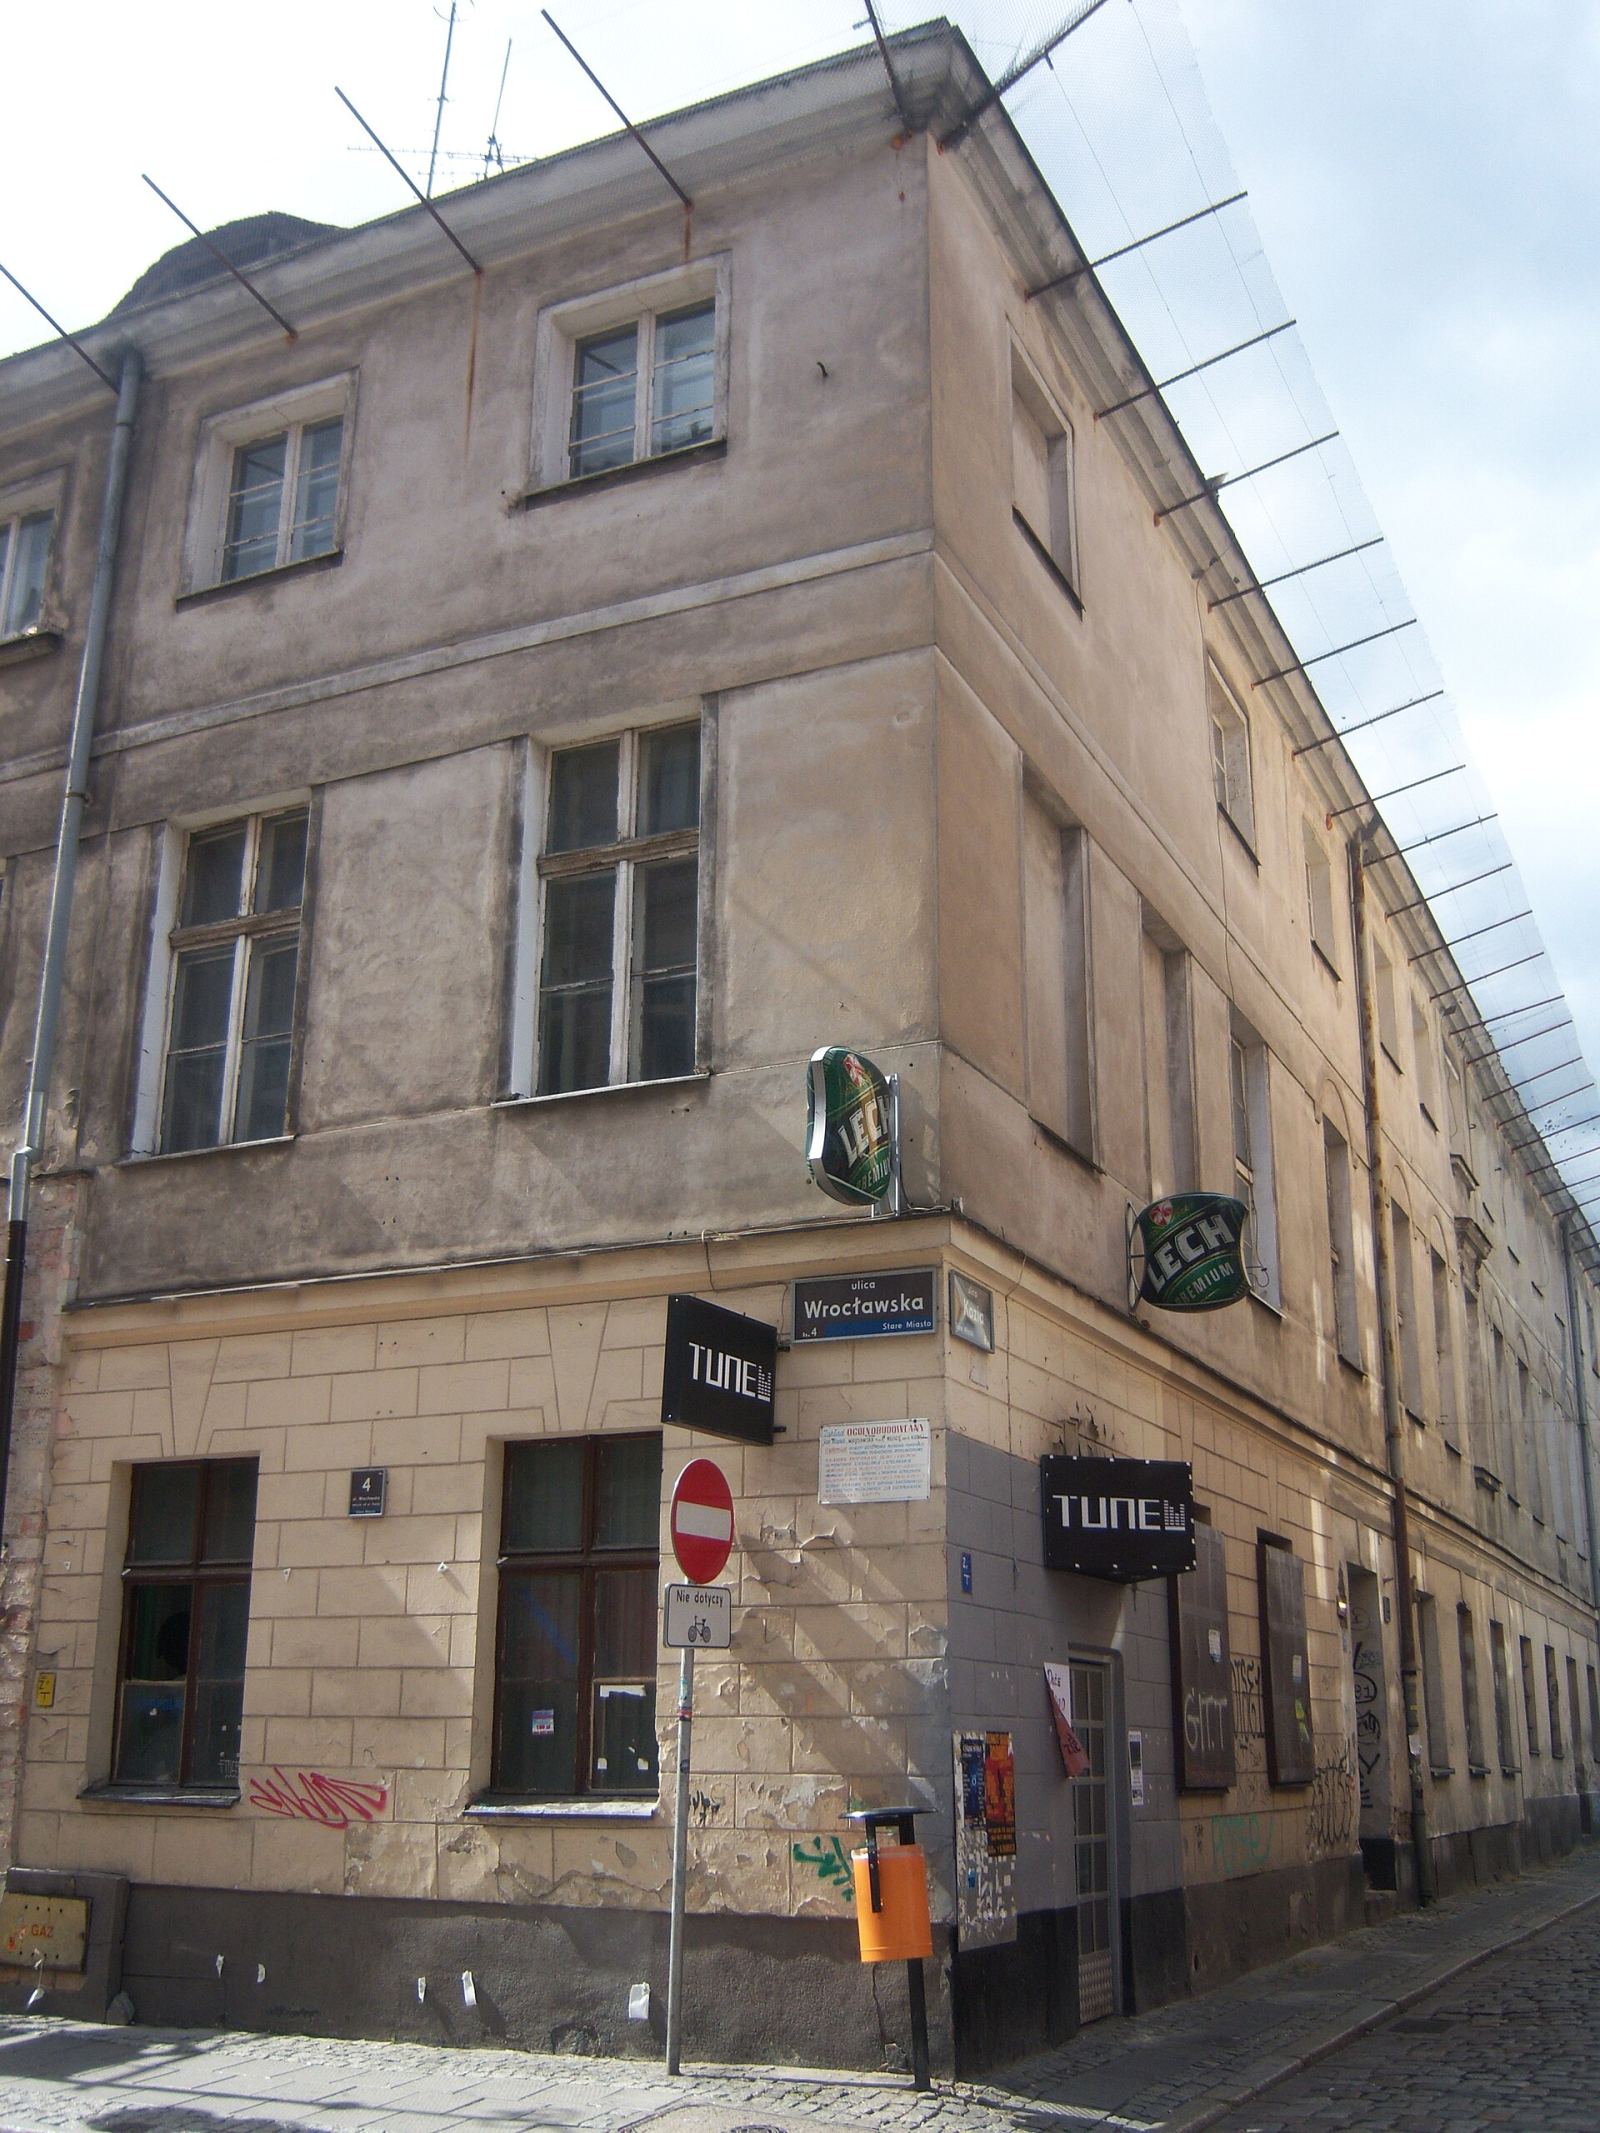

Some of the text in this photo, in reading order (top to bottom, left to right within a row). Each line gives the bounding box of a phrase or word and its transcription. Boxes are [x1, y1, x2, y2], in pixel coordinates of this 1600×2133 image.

[1147, 1214, 1235, 1294] LECH
[851, 1280, 876, 1291] ulica
[803, 1293, 924, 1319] Wrocławska
[882, 1320, 932, 1331] Stare Miasto
[362, 1477, 372, 1492] 4
[676, 1589, 723, 1608] Nie dotyczy
